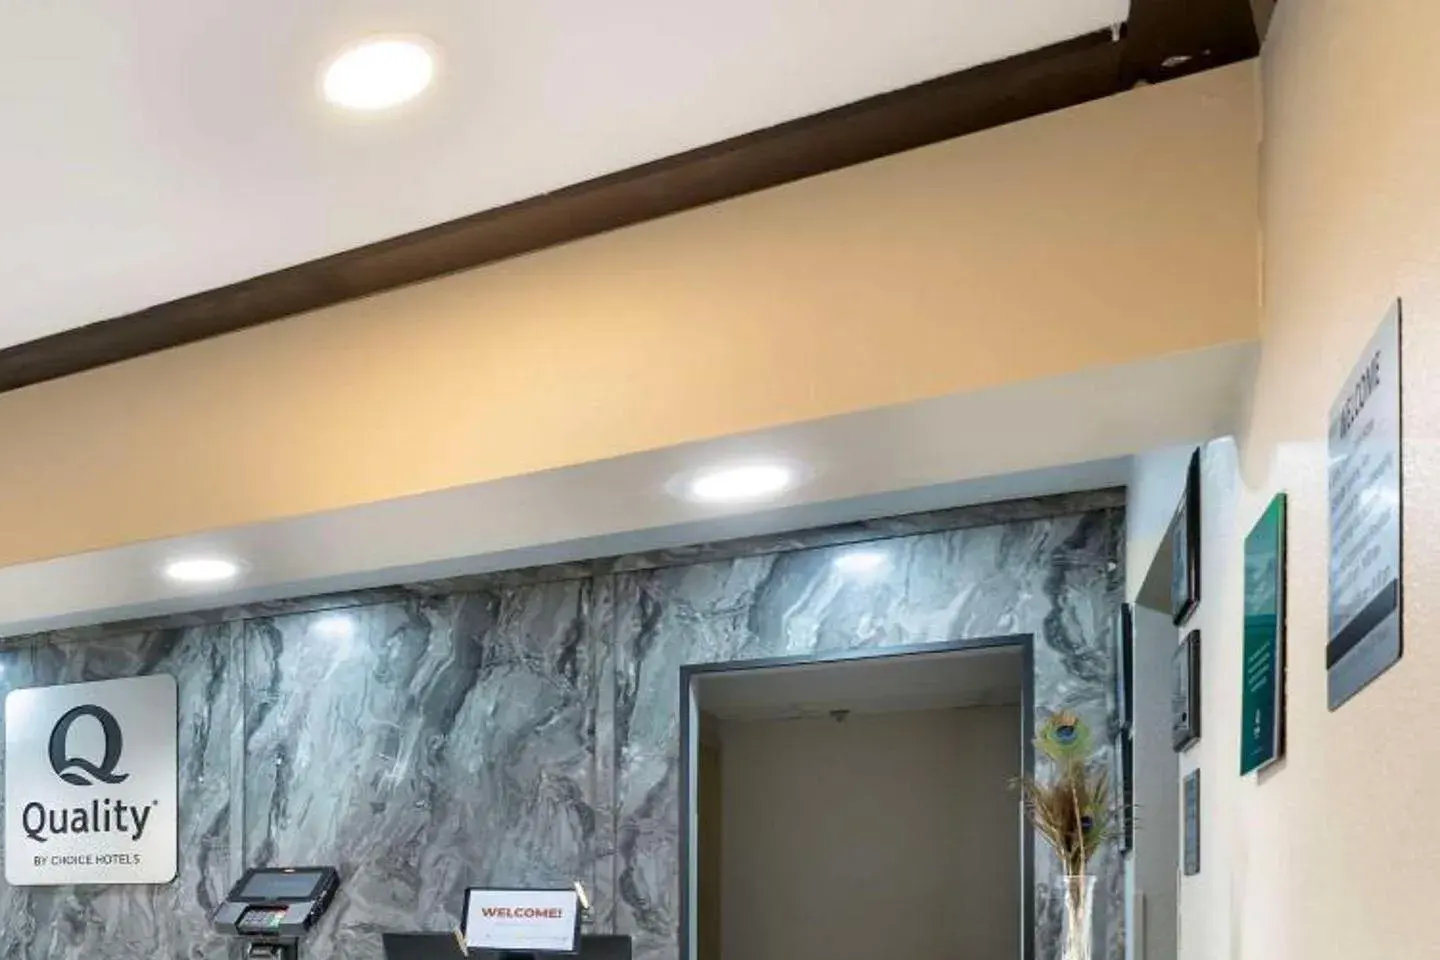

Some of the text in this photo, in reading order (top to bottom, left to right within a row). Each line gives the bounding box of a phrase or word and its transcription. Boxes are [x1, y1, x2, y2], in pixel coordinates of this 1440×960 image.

[48, 704, 130, 786] Q
[33, 853, 141, 867] BY CHOICE HOTELS
[481, 906, 563, 919] WELCOME!
